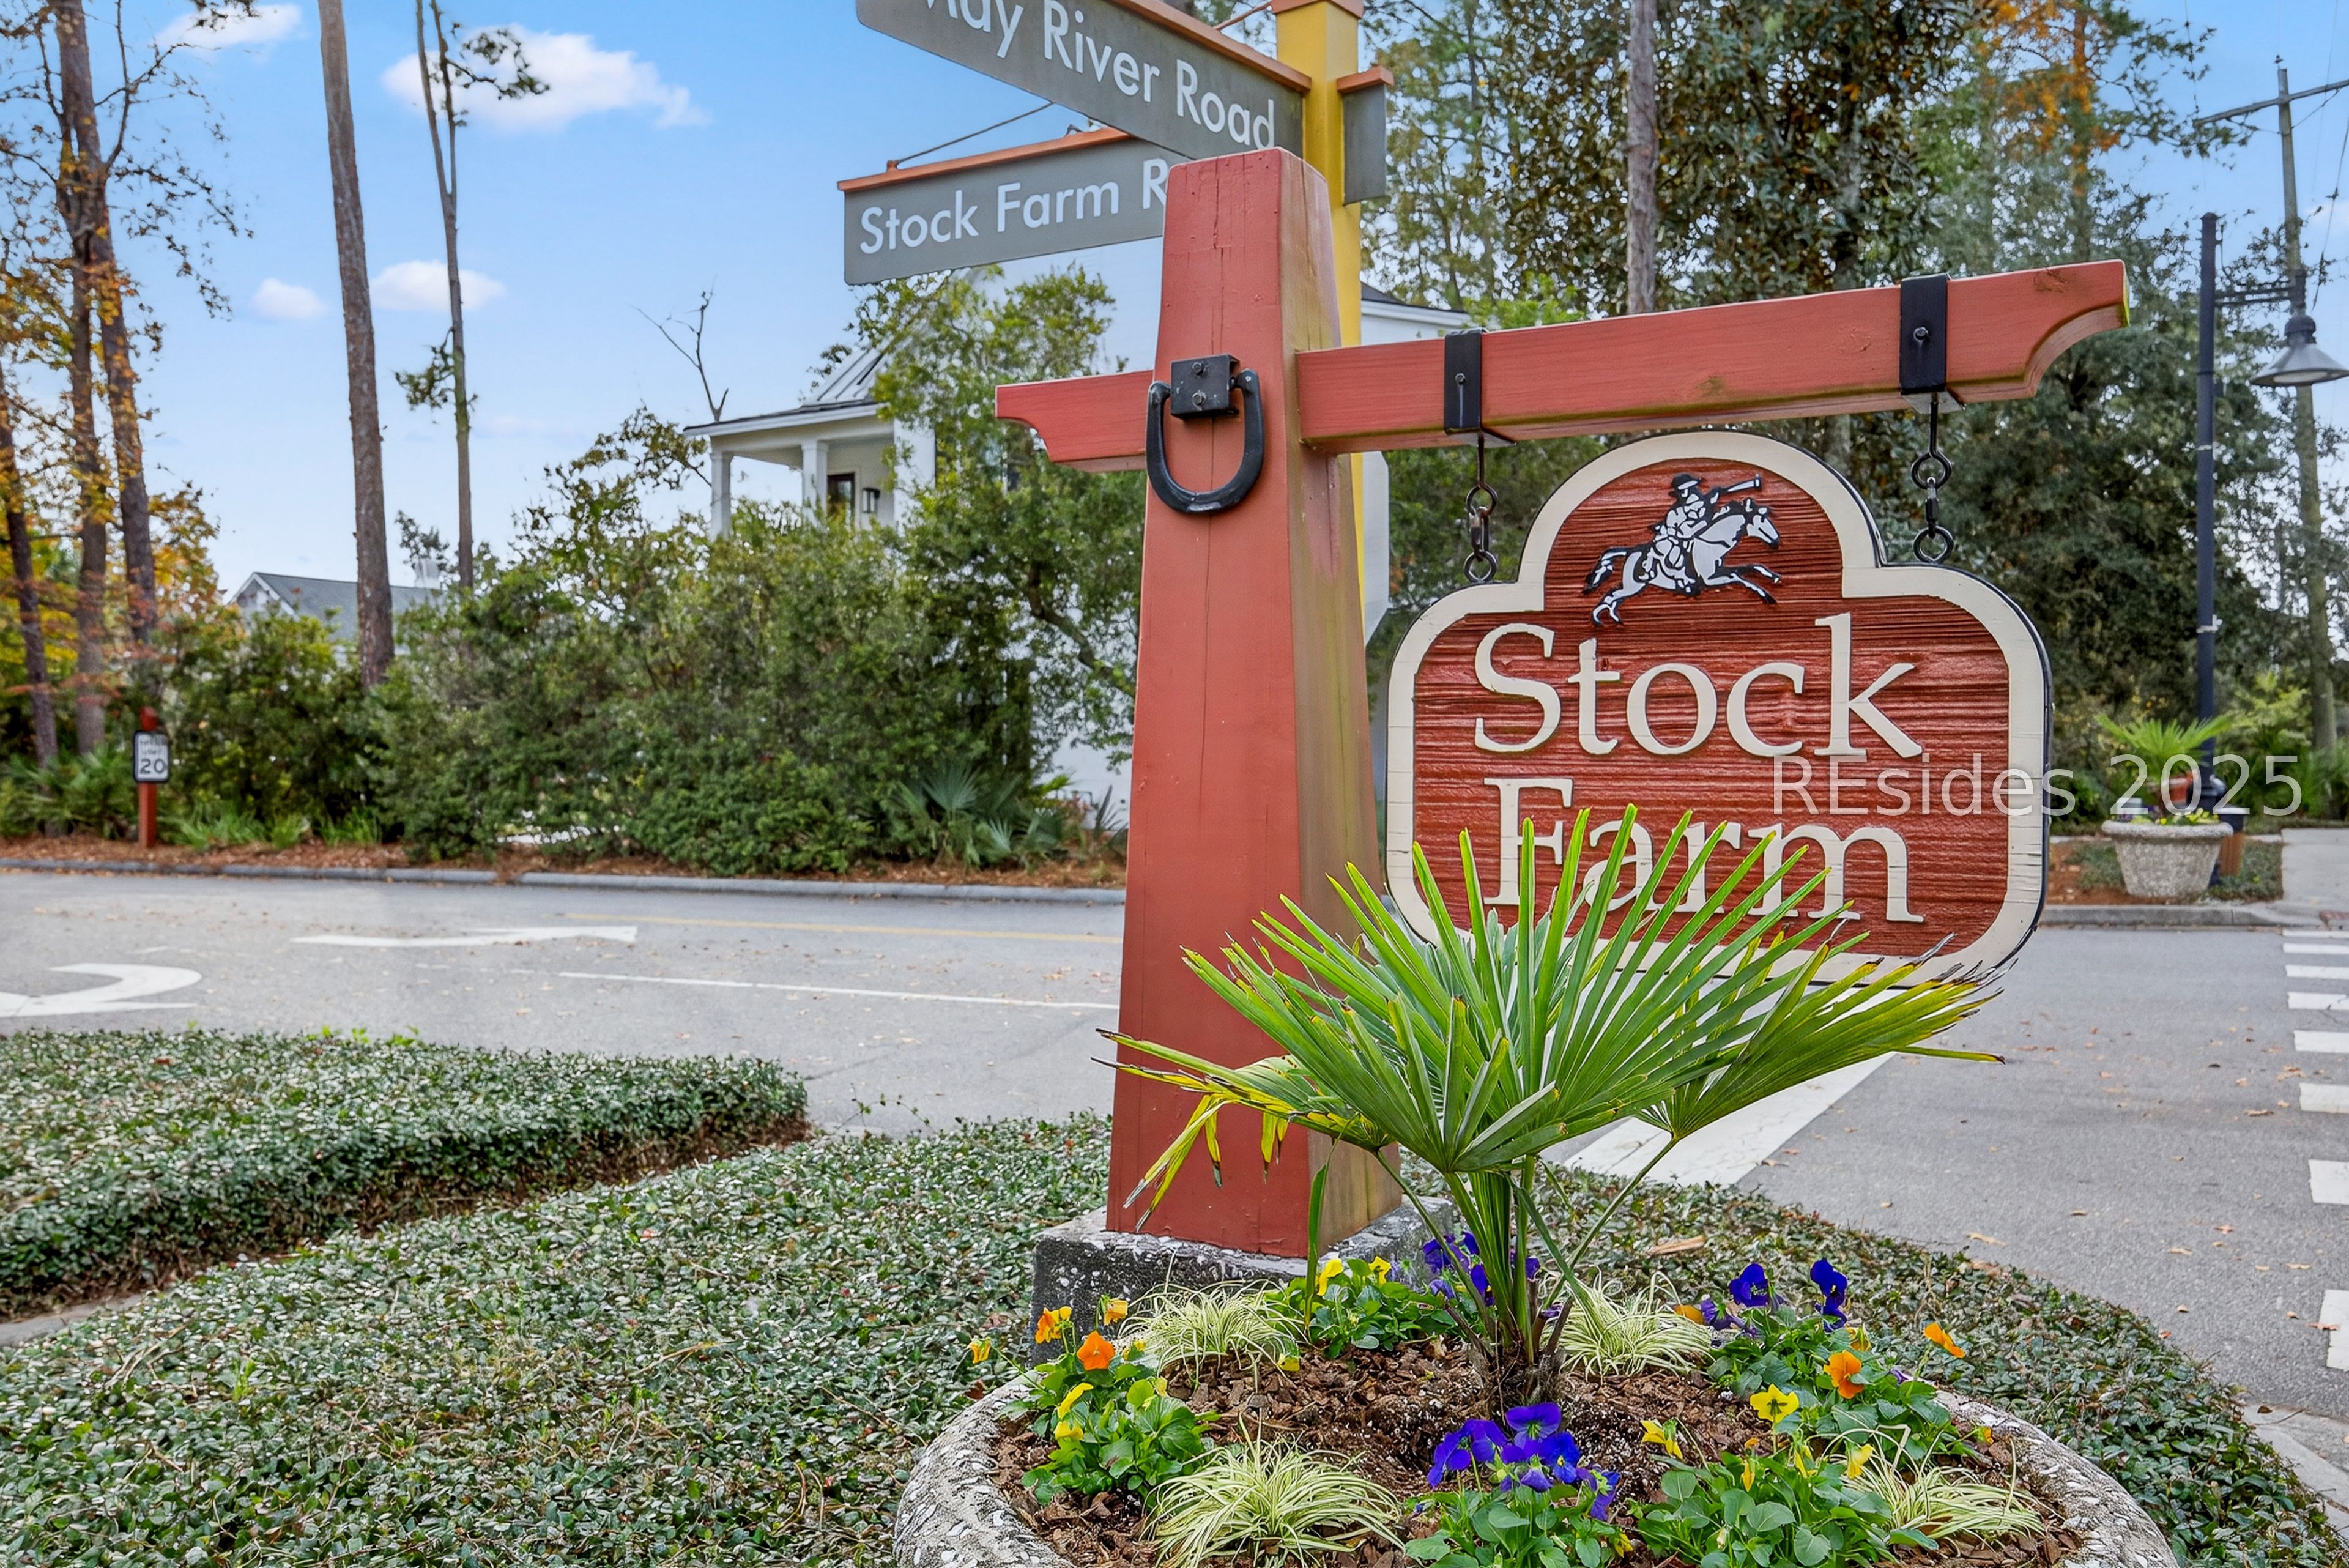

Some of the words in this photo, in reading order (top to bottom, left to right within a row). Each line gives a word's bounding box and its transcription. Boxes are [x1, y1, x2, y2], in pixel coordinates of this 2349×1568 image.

[926, 0, 1024, 59] ay
[1044, 0, 1159, 103] River
[1176, 59, 1275, 149] Road
[859, 190, 979, 255] Stock
[996, 182, 1119, 232] Farm
[1474, 612, 1923, 759] Stock
[140, 759, 167, 774] 20
[1483, 777, 1924, 923] Farm
